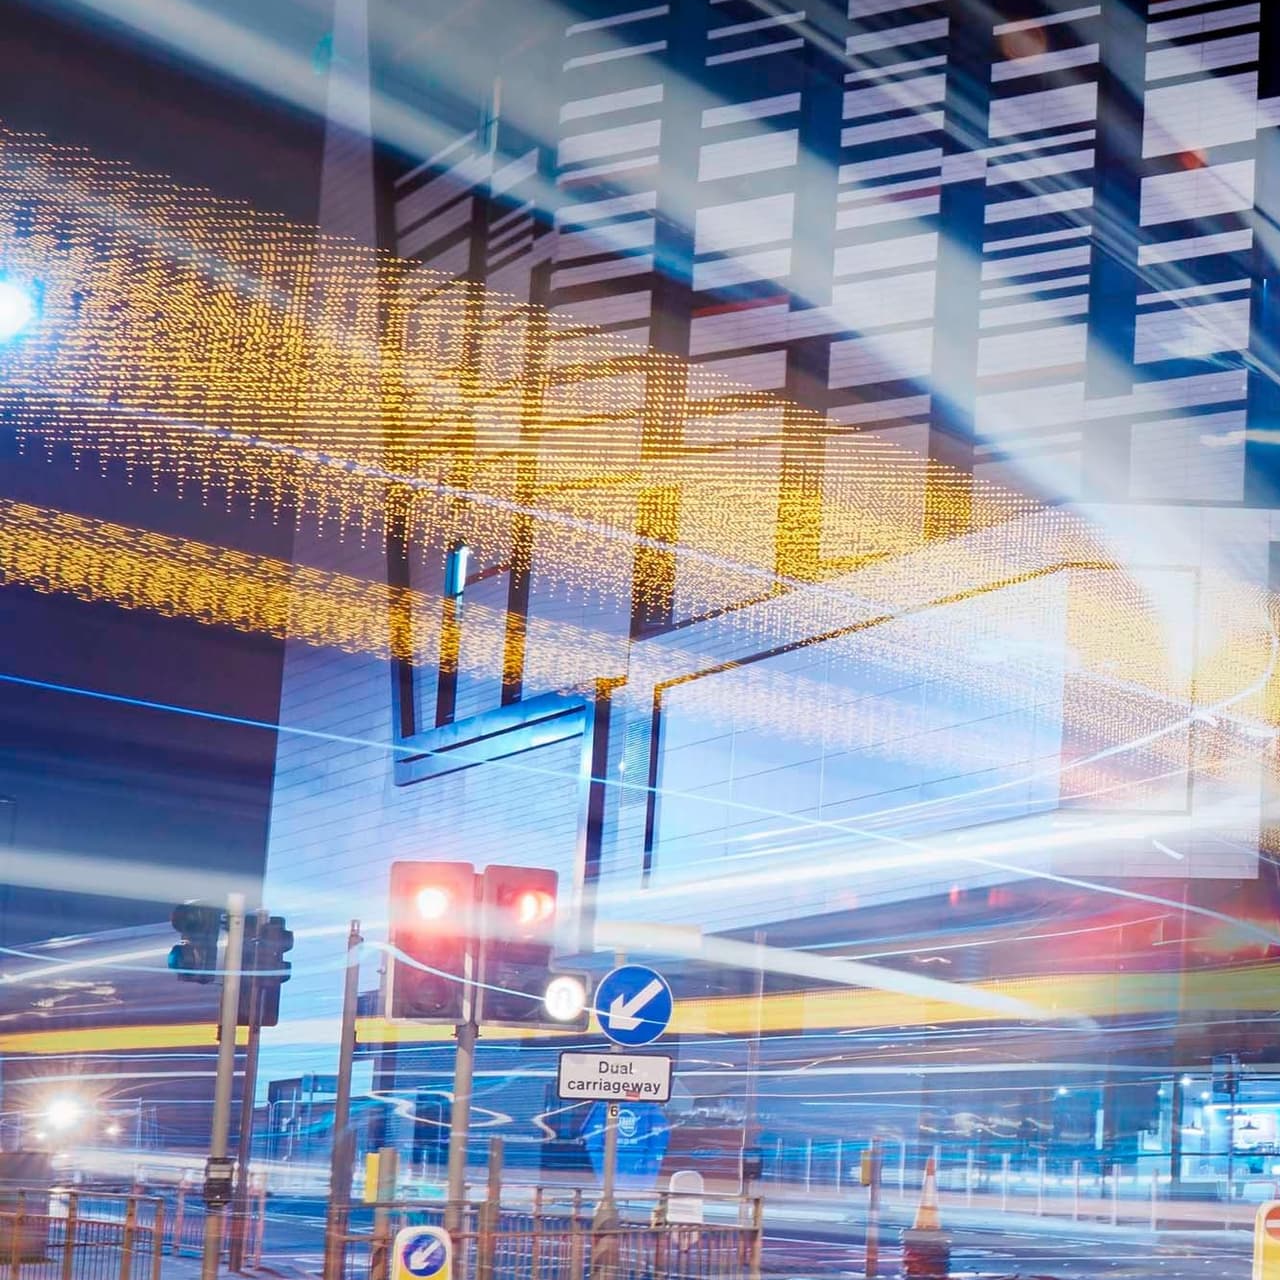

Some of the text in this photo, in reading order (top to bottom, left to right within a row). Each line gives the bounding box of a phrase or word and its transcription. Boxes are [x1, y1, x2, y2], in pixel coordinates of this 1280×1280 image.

[598, 1061, 634, 1075] Dual
[567, 1078, 661, 1095] carriageway
[610, 1105, 618, 1117] 6
